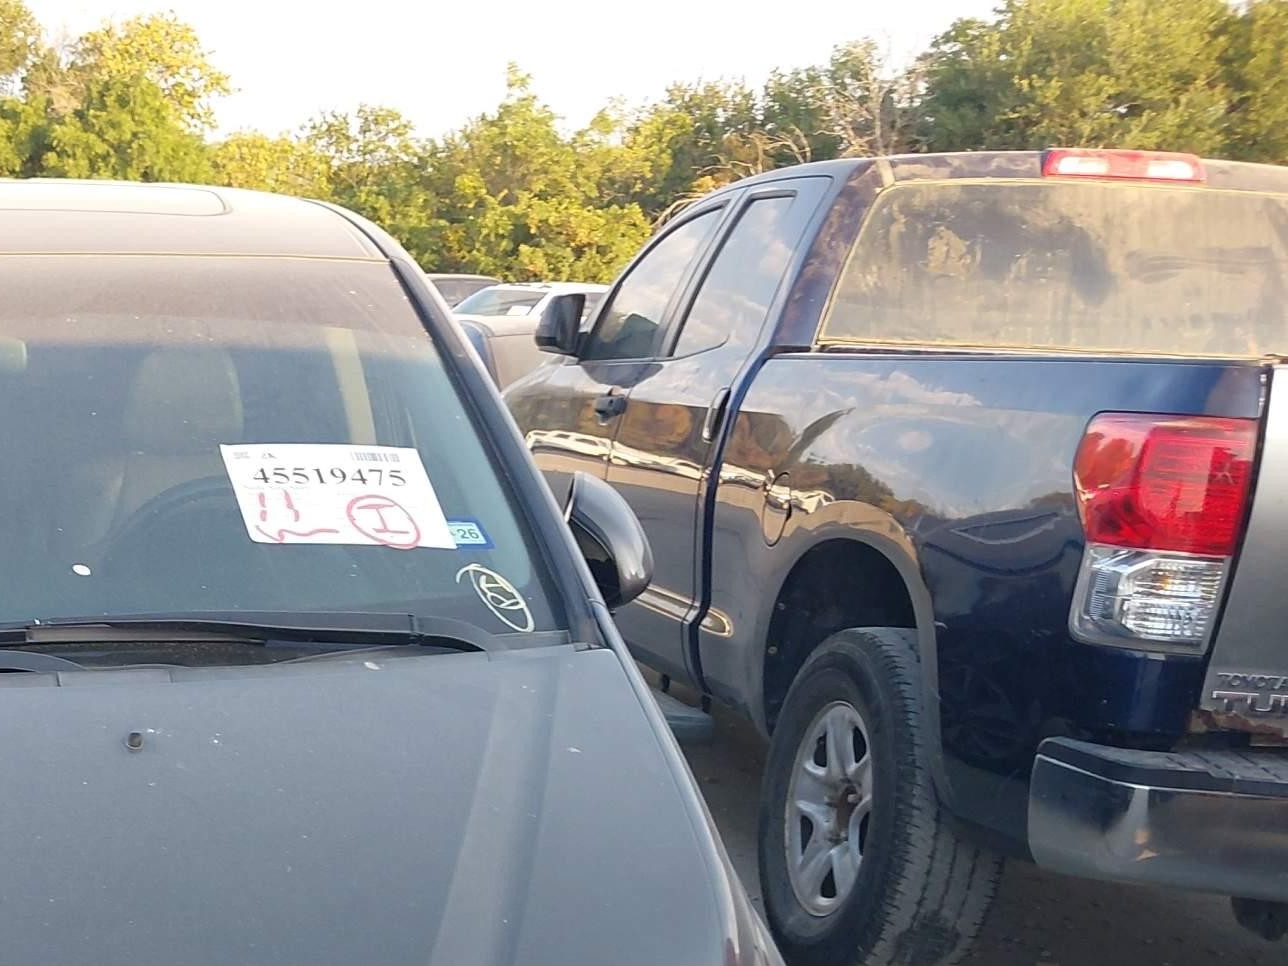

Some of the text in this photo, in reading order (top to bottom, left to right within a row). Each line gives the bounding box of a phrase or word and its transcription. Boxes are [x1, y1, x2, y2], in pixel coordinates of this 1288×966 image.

[253, 466, 407, 487] 45519475
[456, 527, 480, 540] 26
[1216, 672, 1288, 690] TOYOTA
